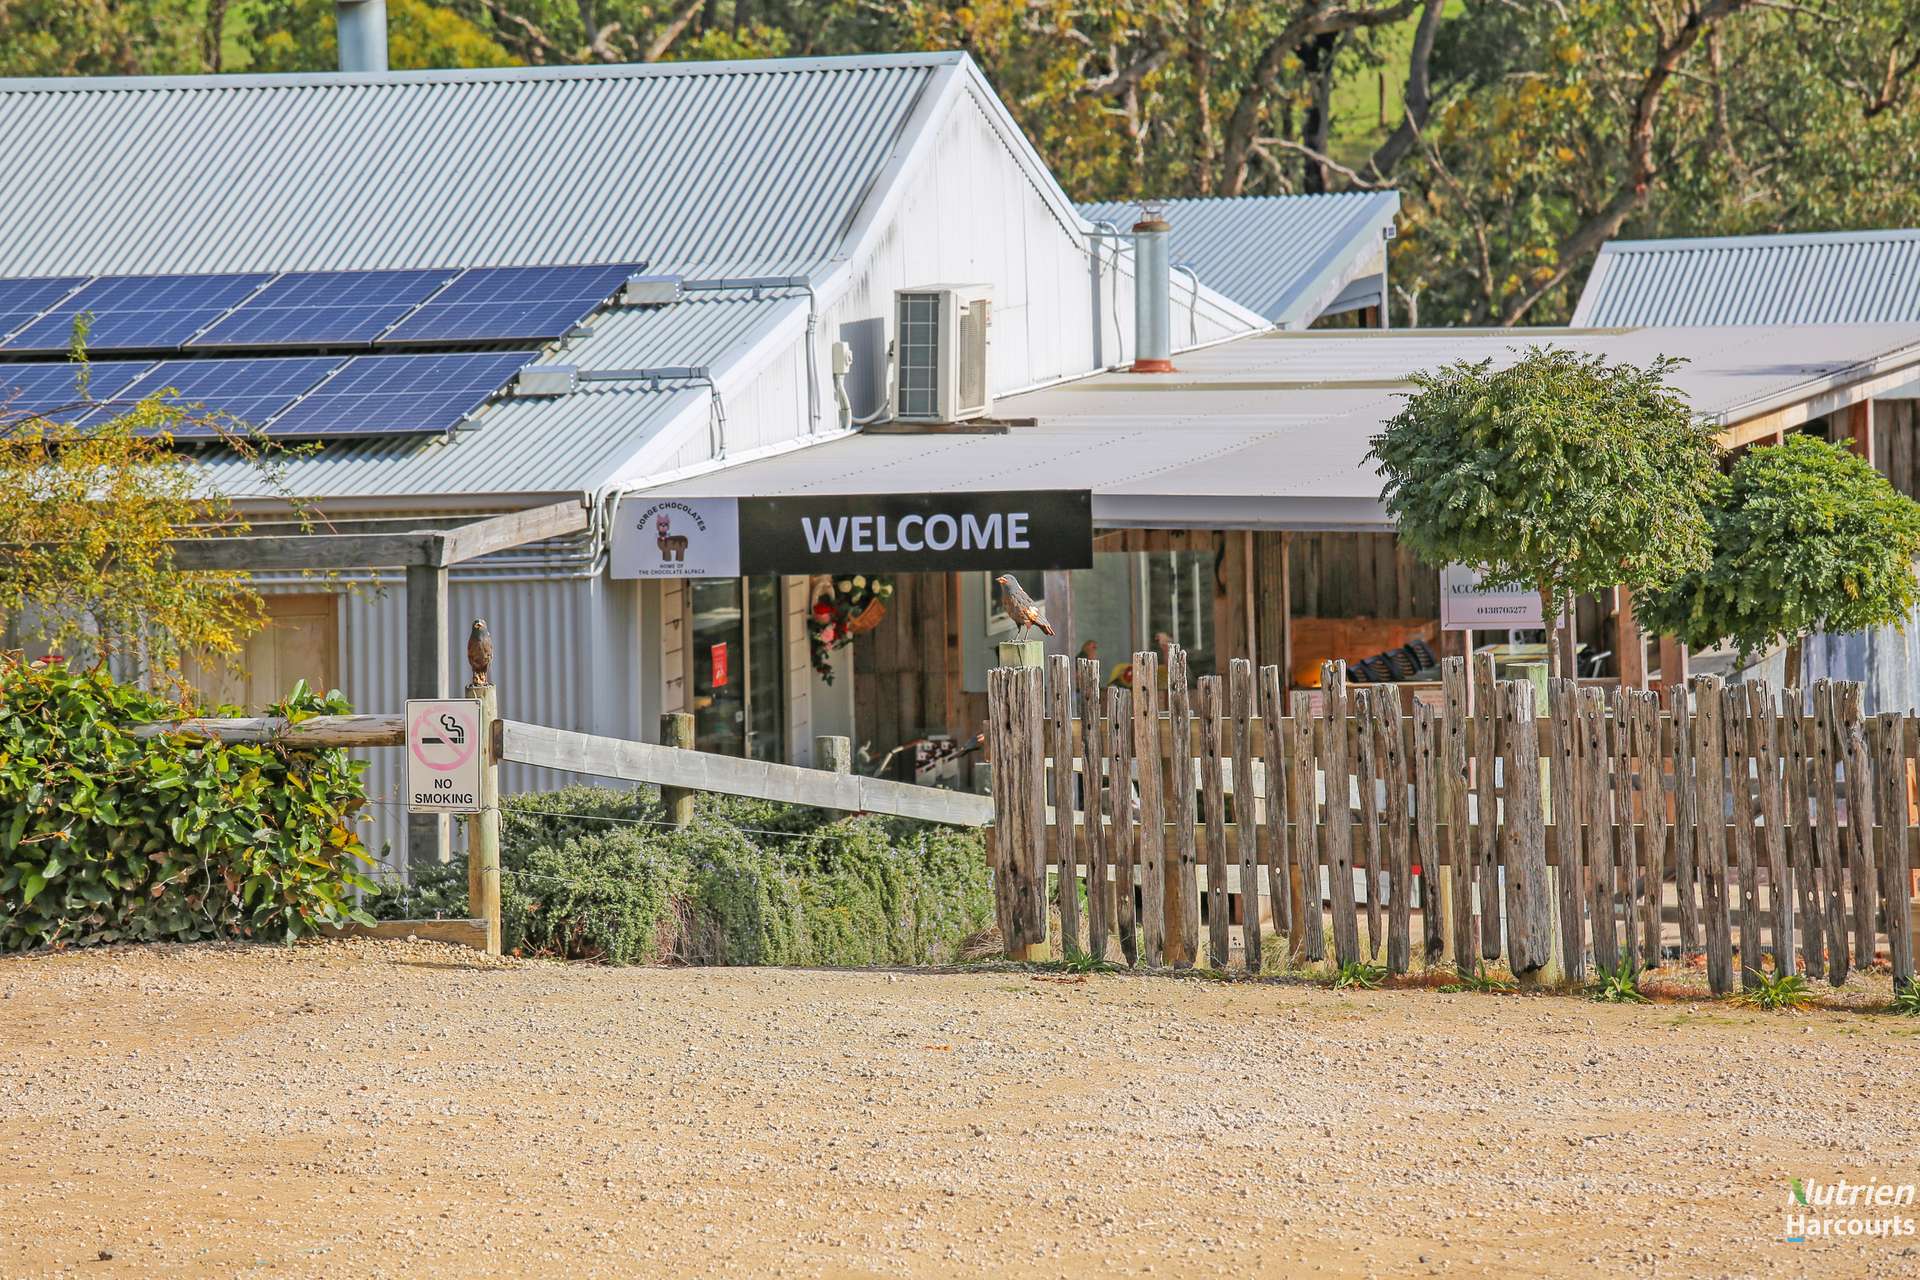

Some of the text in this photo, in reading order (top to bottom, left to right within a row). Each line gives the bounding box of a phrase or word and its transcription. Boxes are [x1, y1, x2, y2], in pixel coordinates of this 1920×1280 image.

[636, 502, 707, 532] GORGE CHOCOLATES
[801, 512, 1031, 554] WELCOME
[434, 778, 453, 790] NO
[414, 793, 473, 804] SMOKING
